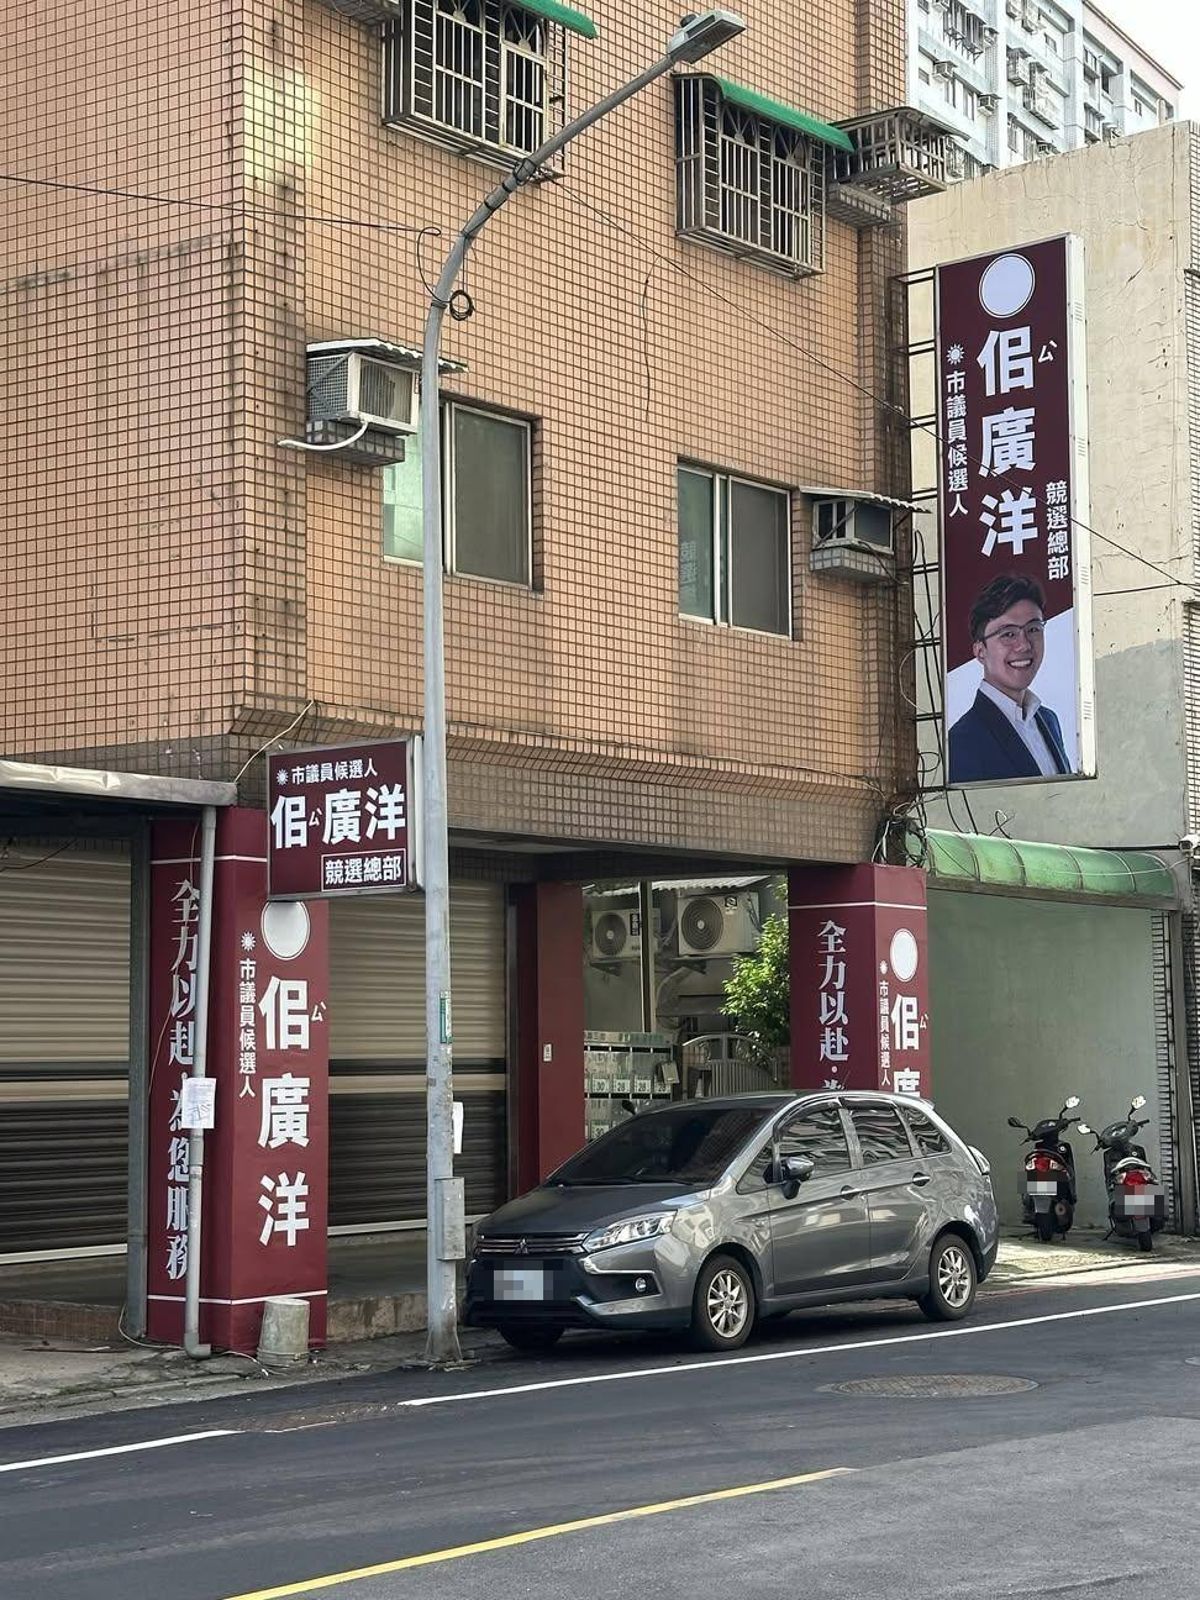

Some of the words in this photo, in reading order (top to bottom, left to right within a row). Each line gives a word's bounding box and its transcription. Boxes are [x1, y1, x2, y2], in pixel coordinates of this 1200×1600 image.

[946, 370, 968, 518] 市議員候選人
[1046, 480, 1069, 580] 競選總部
[291, 758, 378, 785] 市議員候選人
[325, 855, 402, 885] 競選總部
[239, 958, 257, 1098] 市議員候選人
[879, 980, 891, 1086] 市議員候選人
